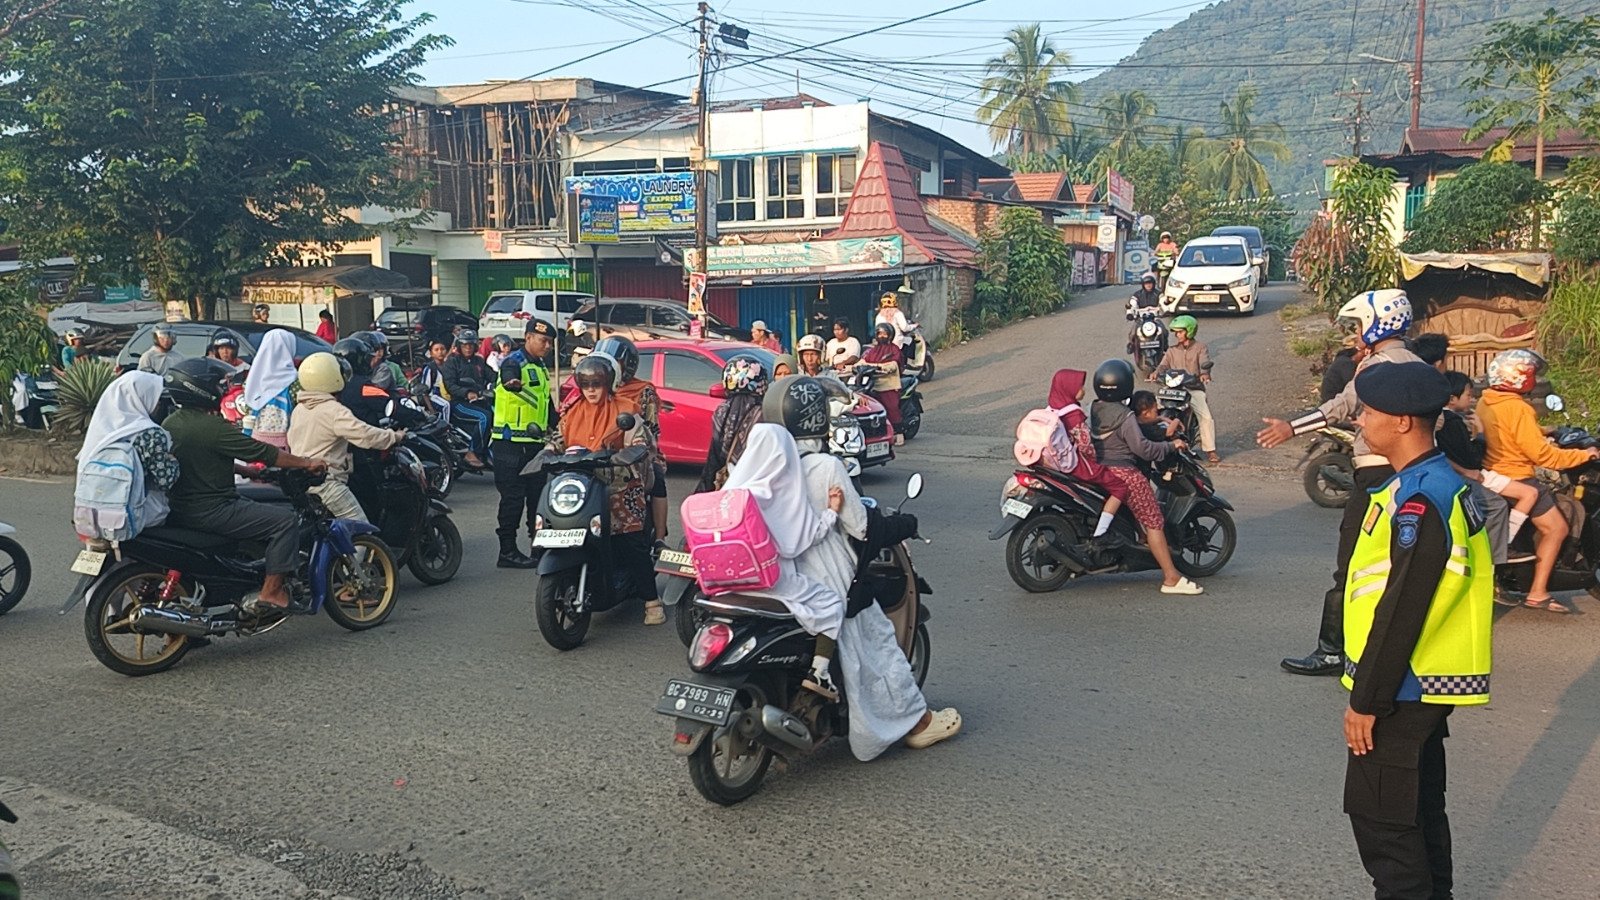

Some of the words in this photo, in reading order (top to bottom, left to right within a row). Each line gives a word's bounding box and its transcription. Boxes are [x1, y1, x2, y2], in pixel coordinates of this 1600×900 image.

[642, 180, 693, 194] LAUNDRY
[651, 195, 682, 203] EXPRESS
[547, 267, 569, 278] Nangka
[671, 553, 690, 563] 2377
[667, 683, 680, 696] BG
[680, 686, 709, 702] 2989
[714, 693, 731, 707] HN
